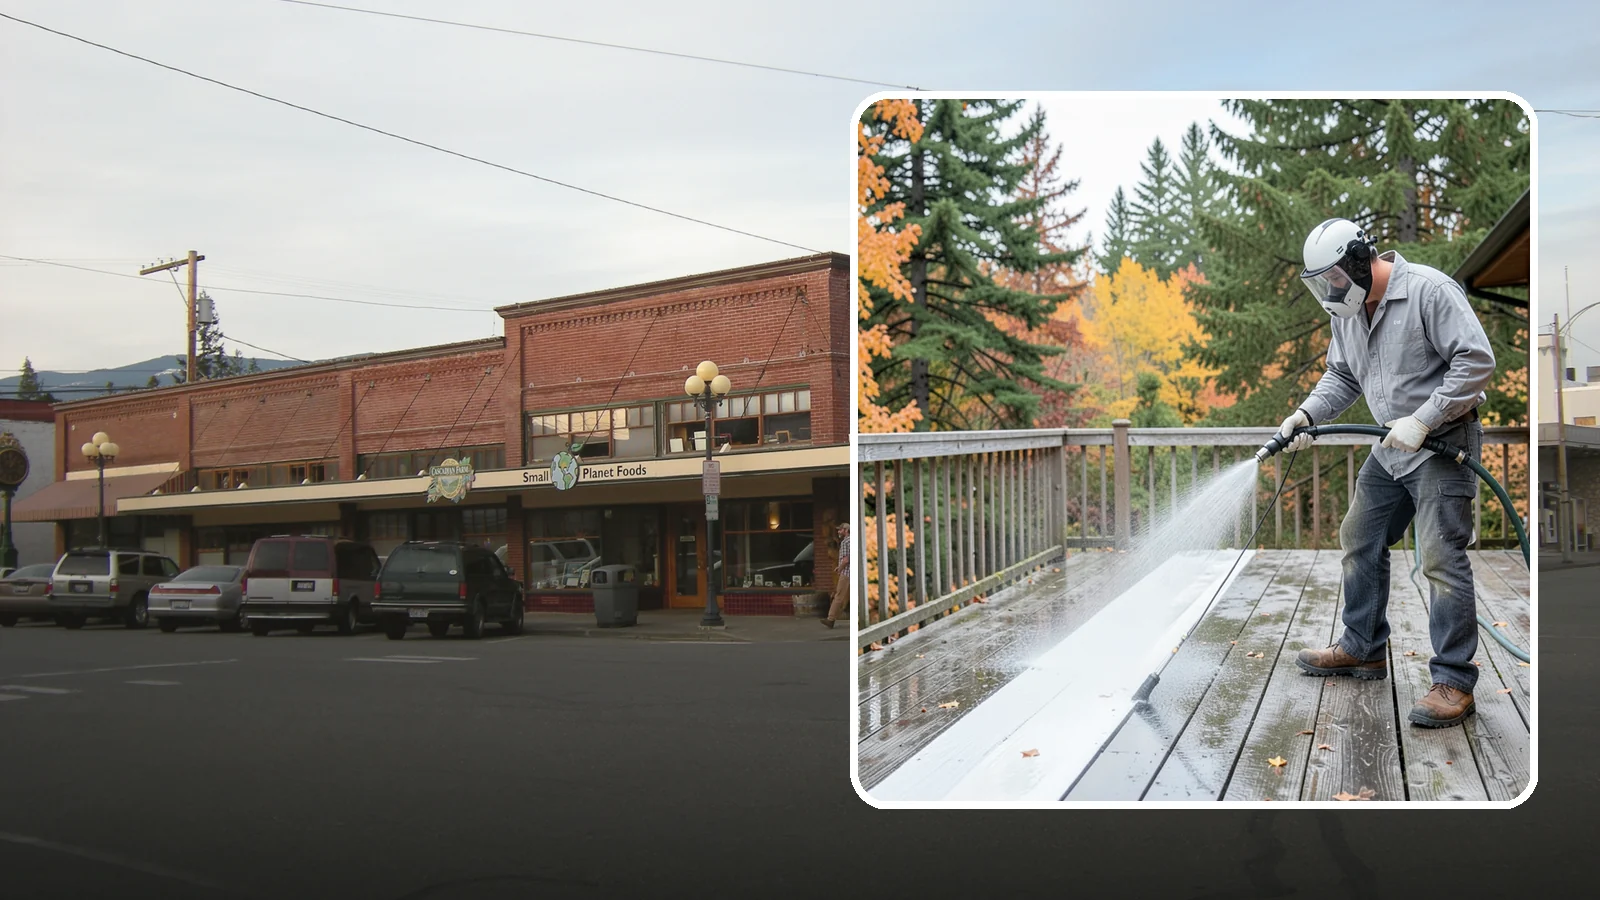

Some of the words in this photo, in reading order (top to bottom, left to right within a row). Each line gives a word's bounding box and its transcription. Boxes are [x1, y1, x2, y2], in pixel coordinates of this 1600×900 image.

[431, 466, 455, 476] CASCADIAN
[523, 470, 549, 483] Small
[582, 467, 614, 479] Planet
[616, 464, 647, 477] Foods
